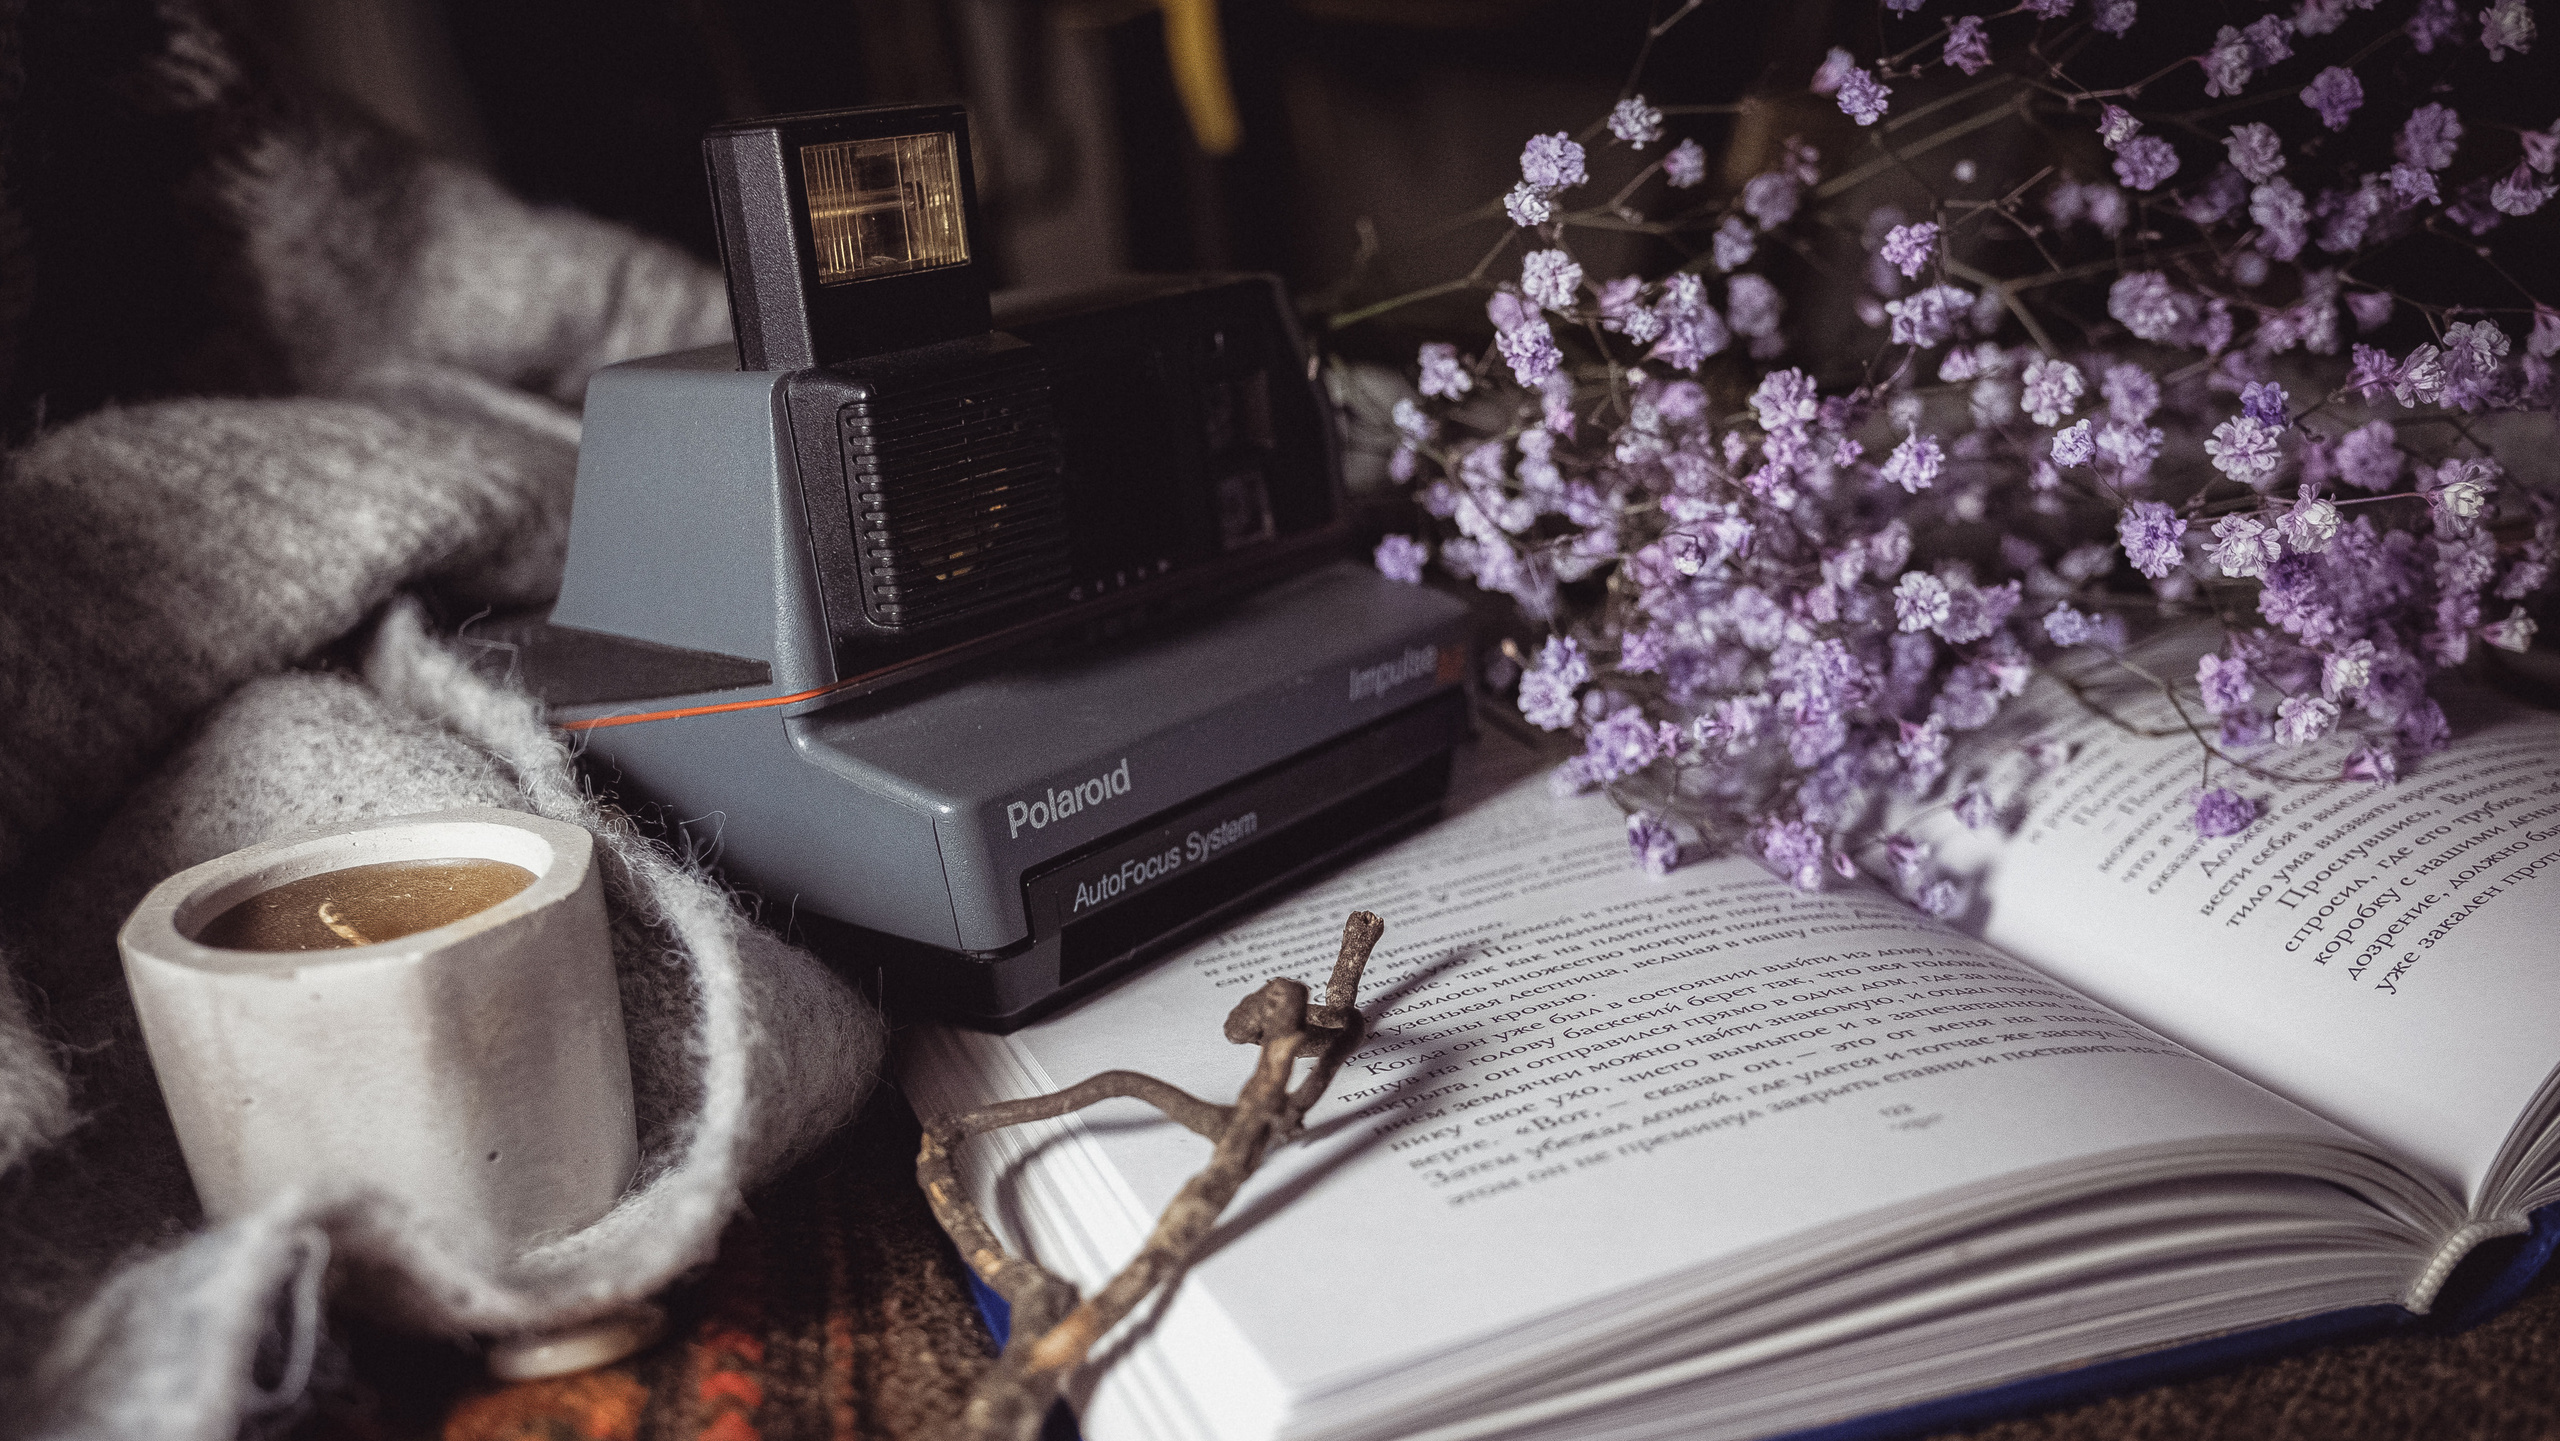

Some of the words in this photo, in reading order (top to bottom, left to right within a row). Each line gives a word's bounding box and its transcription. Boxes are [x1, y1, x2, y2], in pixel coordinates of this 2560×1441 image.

[1349, 644, 1438, 701] Impulse
[1006, 757, 1132, 839] Polaroid
[1073, 846, 1182, 913] AutoFocus
[1185, 811, 1258, 863] System
[2200, 866, 2253, 917] вести
[2252, 831, 2298, 866] себя
[2225, 884, 2273, 929] тило
[2272, 850, 2316, 885] ума
[2314, 800, 2397, 850] вызвать
[2275, 808, 2442, 911] Проснувшись,
[2284, 874, 2378, 953] спросил,
[2376, 845, 2414, 870] где
[2414, 824, 2452, 846] его
[2451, 796, 2536, 828] трубка,
[2313, 887, 2401, 966] коробку
[2400, 876, 2417, 887] с
[2414, 825, 2507, 877] нашими
[2347, 892, 2450, 982] дозрение,
[2448, 841, 2530, 891] должно
[1355, 980, 1450, 1008] ечение,
[1457, 965, 1497, 980] так
[1505, 953, 1546, 969] как
[1553, 944, 1583, 957] на
[1366, 1031, 1383, 1041] и
[1389, 998, 1502, 1035] узенькая
[1510, 968, 1628, 1002] лестница,
[1724, 940, 1739, 949] в
[1743, 928, 1806, 945] нашу
[1381, 986, 1487, 1019] валялось
[1491, 950, 1624, 989] множество
[1628, 928, 1721, 954] мокрых
[2374, 951, 2421, 995] уже
[2417, 885, 2505, 950] закален
[1338, 1076, 1421, 1103] тянув
[1427, 1065, 1462, 1080] на
[1469, 1036, 1555, 1067] голову
[1563, 1002, 1682, 1040] баскский
[1687, 985, 1756, 1007] берет
[1762, 977, 1814, 990] так,
[1817, 967, 1861, 979] что
[1867, 962, 1907, 973] вся
[1344, 1020, 1485, 1068] репачканы
[1490, 993, 1595, 1024] кровью.
[1363, 1050, 1446, 1076] Когда
[1453, 1037, 1488, 1052] он
[1492, 1022, 1545, 1044] уже
[1549, 1007, 1603, 1025] был
[1607, 1001, 1623, 1010] в
[1628, 968, 1758, 1005] состоянии
[1762, 954, 1838, 973] выйти
[1841, 951, 1871, 960] из
[1453, 1069, 1582, 1112] землячки
[1588, 1043, 1681, 1073] можно
[1685, 1022, 1762, 1047] найти
[1765, 996, 1904, 1027] знакомую,
[1905, 992, 1925, 1001] и
[1927, 986, 1993, 998] отдал
[1485, 1066, 1520, 1082] он
[1527, 1023, 1678, 1070] отправился
[1683, 1003, 1767, 1028] прямо
[1771, 998, 1788, 1007] в
[1792, 985, 1854, 1002] один
[1862, 977, 1918, 992] дом,
[1920, 973, 1958, 983] где
[1959, 973, 1988, 981] за
[1644, 1072, 1734, 1101] сказал
[1744, 1058, 1792, 1073] он,
[1831, 1037, 1876, 1053] это
[1887, 1029, 1916, 1040] от
[1924, 1018, 1995, 1034] меня
[2003, 1015, 2037, 1024] на
[1747, 1078, 1789, 1096] где
[1884, 1051, 1905, 1062] и
[1907, 1036, 1994, 1056] тотчас
[1996, 1032, 2034, 1042] же
[1883, 1059, 1975, 1083] ставни
[1977, 1055, 1998, 1065] и
[2000, 1045, 2126, 1062] поставить
[1391, 1124, 1461, 1152] нику
[1474, 1103, 1538, 1127] свое
[1546, 1085, 1611, 1109] ухо,
[1619, 1059, 1698, 1083] чисто
[1708, 1027, 1831, 1062] вымытое
[1837, 1021, 1858, 1031] и
[1864, 1017, 1882, 1026] в
[1888, 1000, 2064, 1022] запечатанном
